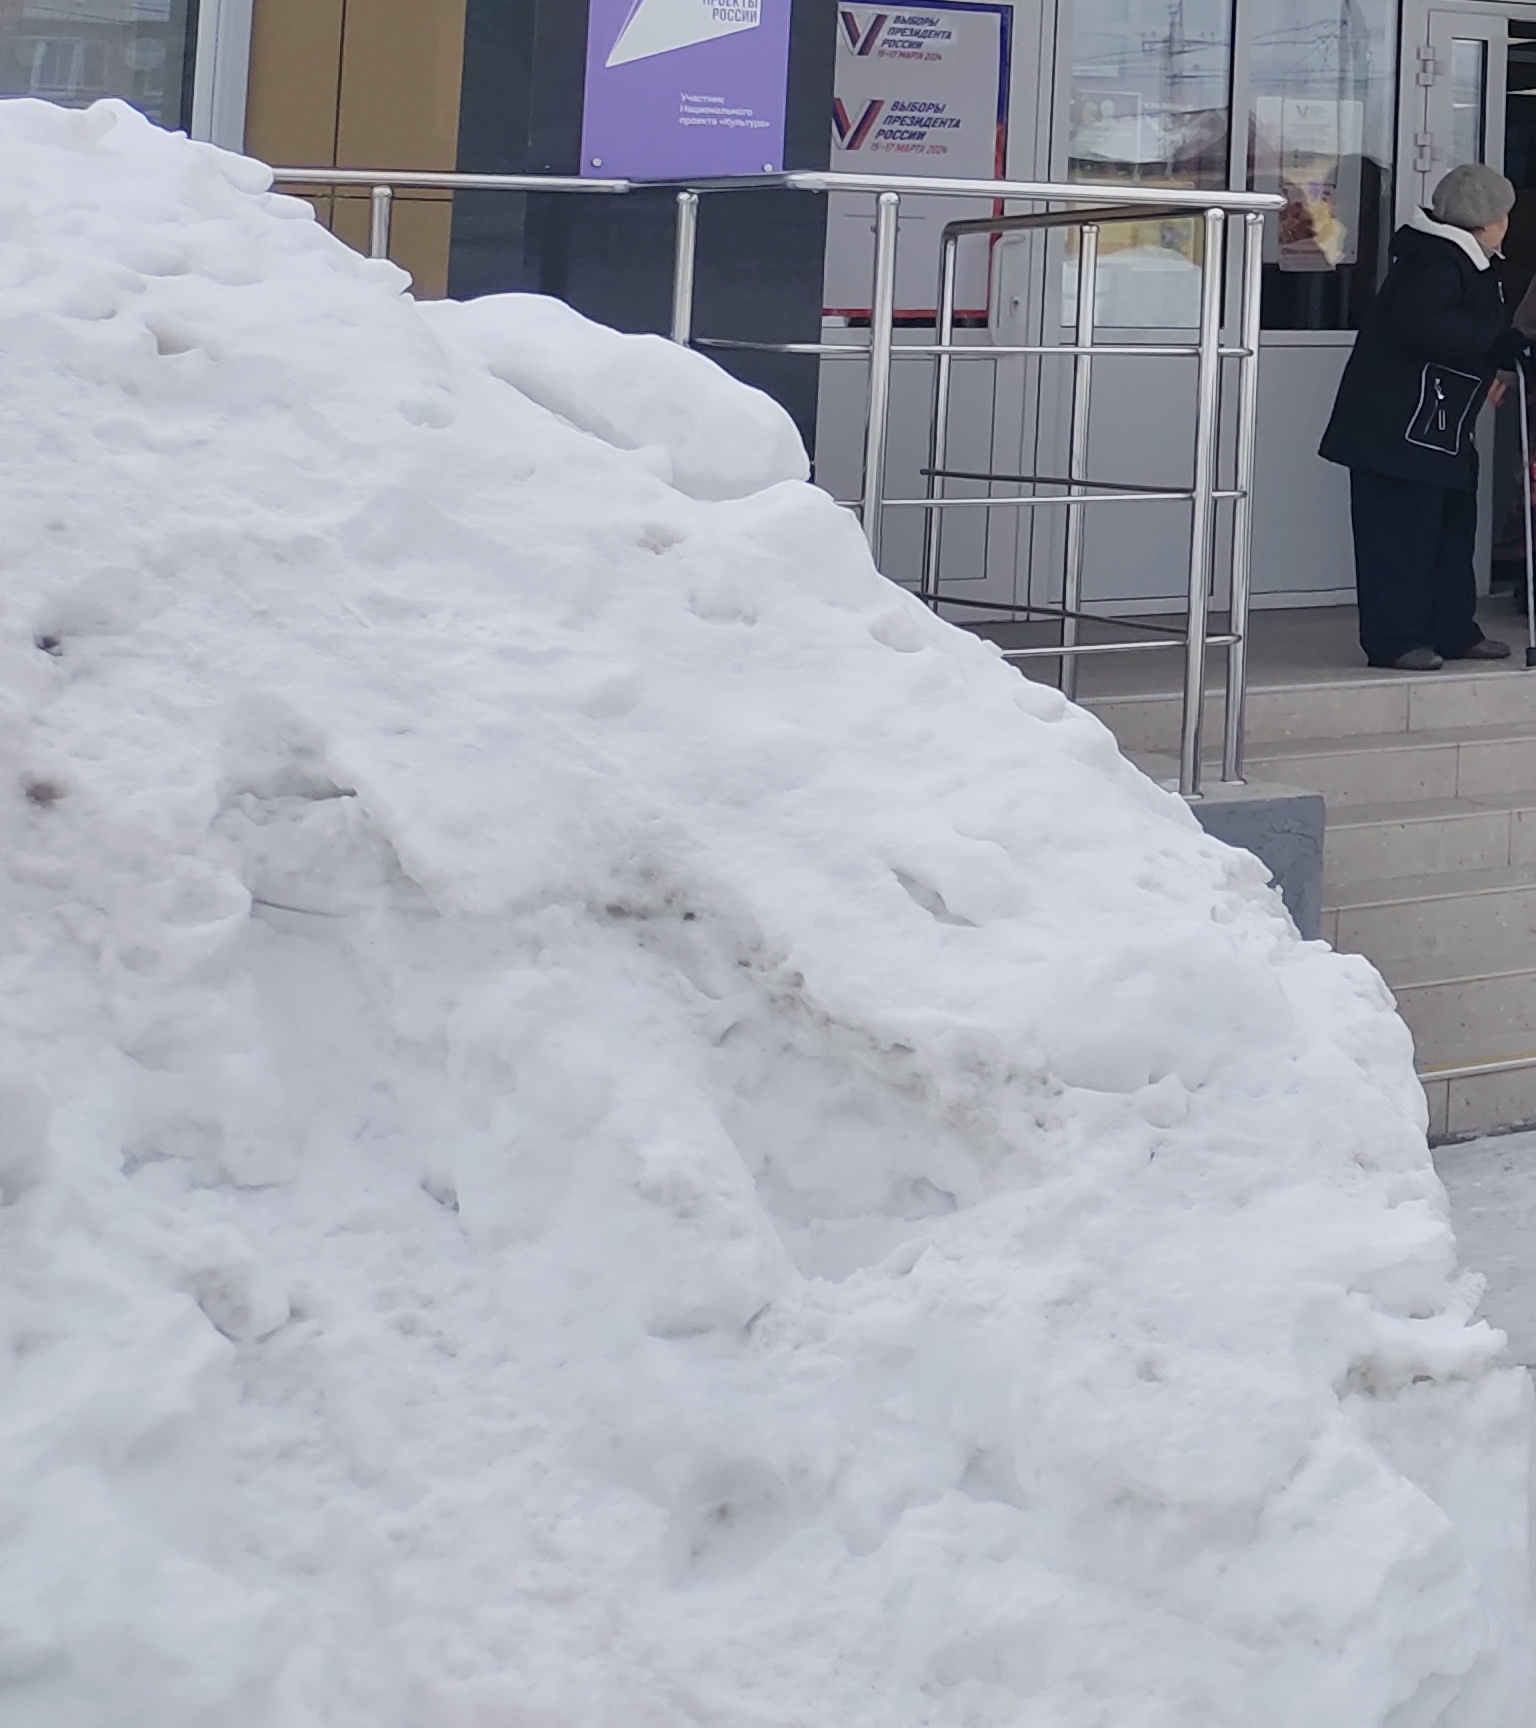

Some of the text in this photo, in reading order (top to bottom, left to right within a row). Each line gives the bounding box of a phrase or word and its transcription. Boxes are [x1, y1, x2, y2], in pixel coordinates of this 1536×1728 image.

[712, 8, 758, 23] РОССИИ
[894, 15, 940, 26] ВЫБОРЫ
[887, 27, 953, 40] ПРЕЗИДЕНТА
[881, 39, 924, 49] РОССИИ
[890, 101, 947, 114] ВЫБОРЫ
[883, 115, 961, 129] ПРЕЗИДЕНТА
[875, 129, 927, 141] РОССИИ
